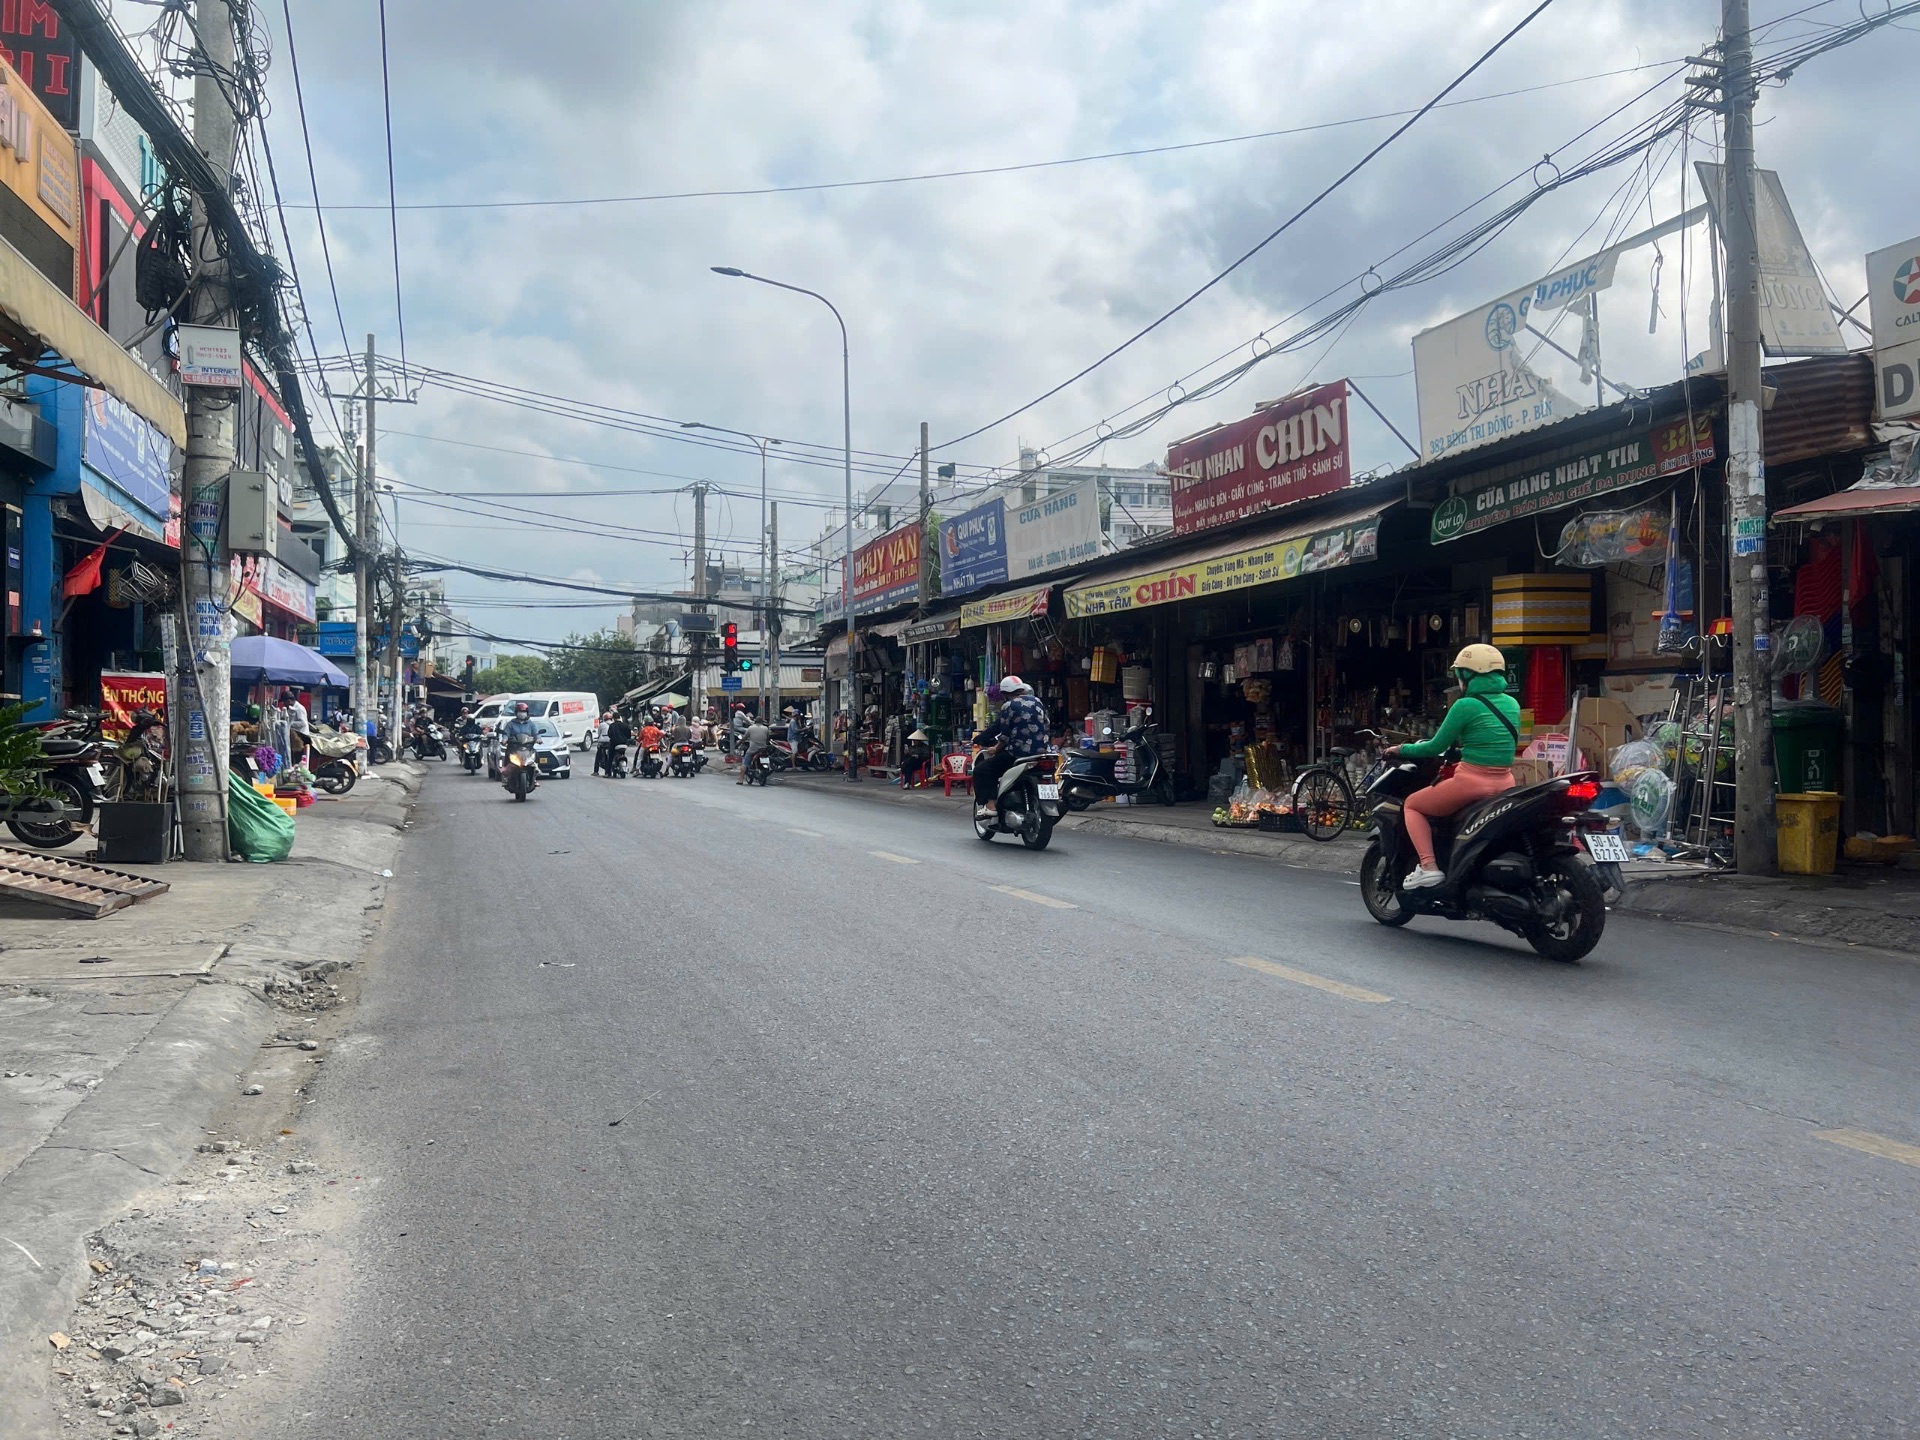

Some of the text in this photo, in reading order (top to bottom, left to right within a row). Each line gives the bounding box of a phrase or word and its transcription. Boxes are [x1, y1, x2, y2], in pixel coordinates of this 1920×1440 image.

[201, 367, 237, 375] INTERNET
[1882, 358, 1920, 408] D
[1430, 437, 1444, 455] 382
[1471, 425, 1485, 442] TRỊ
[1662, 415, 1711, 453] 382
[1268, 471, 1291, 490] TRANG
[1293, 463, 1307, 481] THỜ
[1312, 458, 1331, 476] SÀNH
[1567, 477, 1594, 498] GHẾ
[1617, 464, 1657, 484] DỤNG
[1476, 485, 1505, 511] CỬA
[1509, 471, 1550, 500] HÀNG
[1019, 506, 1041, 524] CỬA
[1438, 513, 1463, 532] DUY LỢI
[1206, 562, 1223, 577] Chuyên:
[1136, 572, 1197, 605] CHÍN
[1110, 596, 1131, 610] TÂM
[121, 686, 164, 703] THỐNG
[1465, 802, 1512, 835] VARIO
[1591, 835, 1619, 848] 50-AC
[1594, 848, 1627, 861] 627.61
